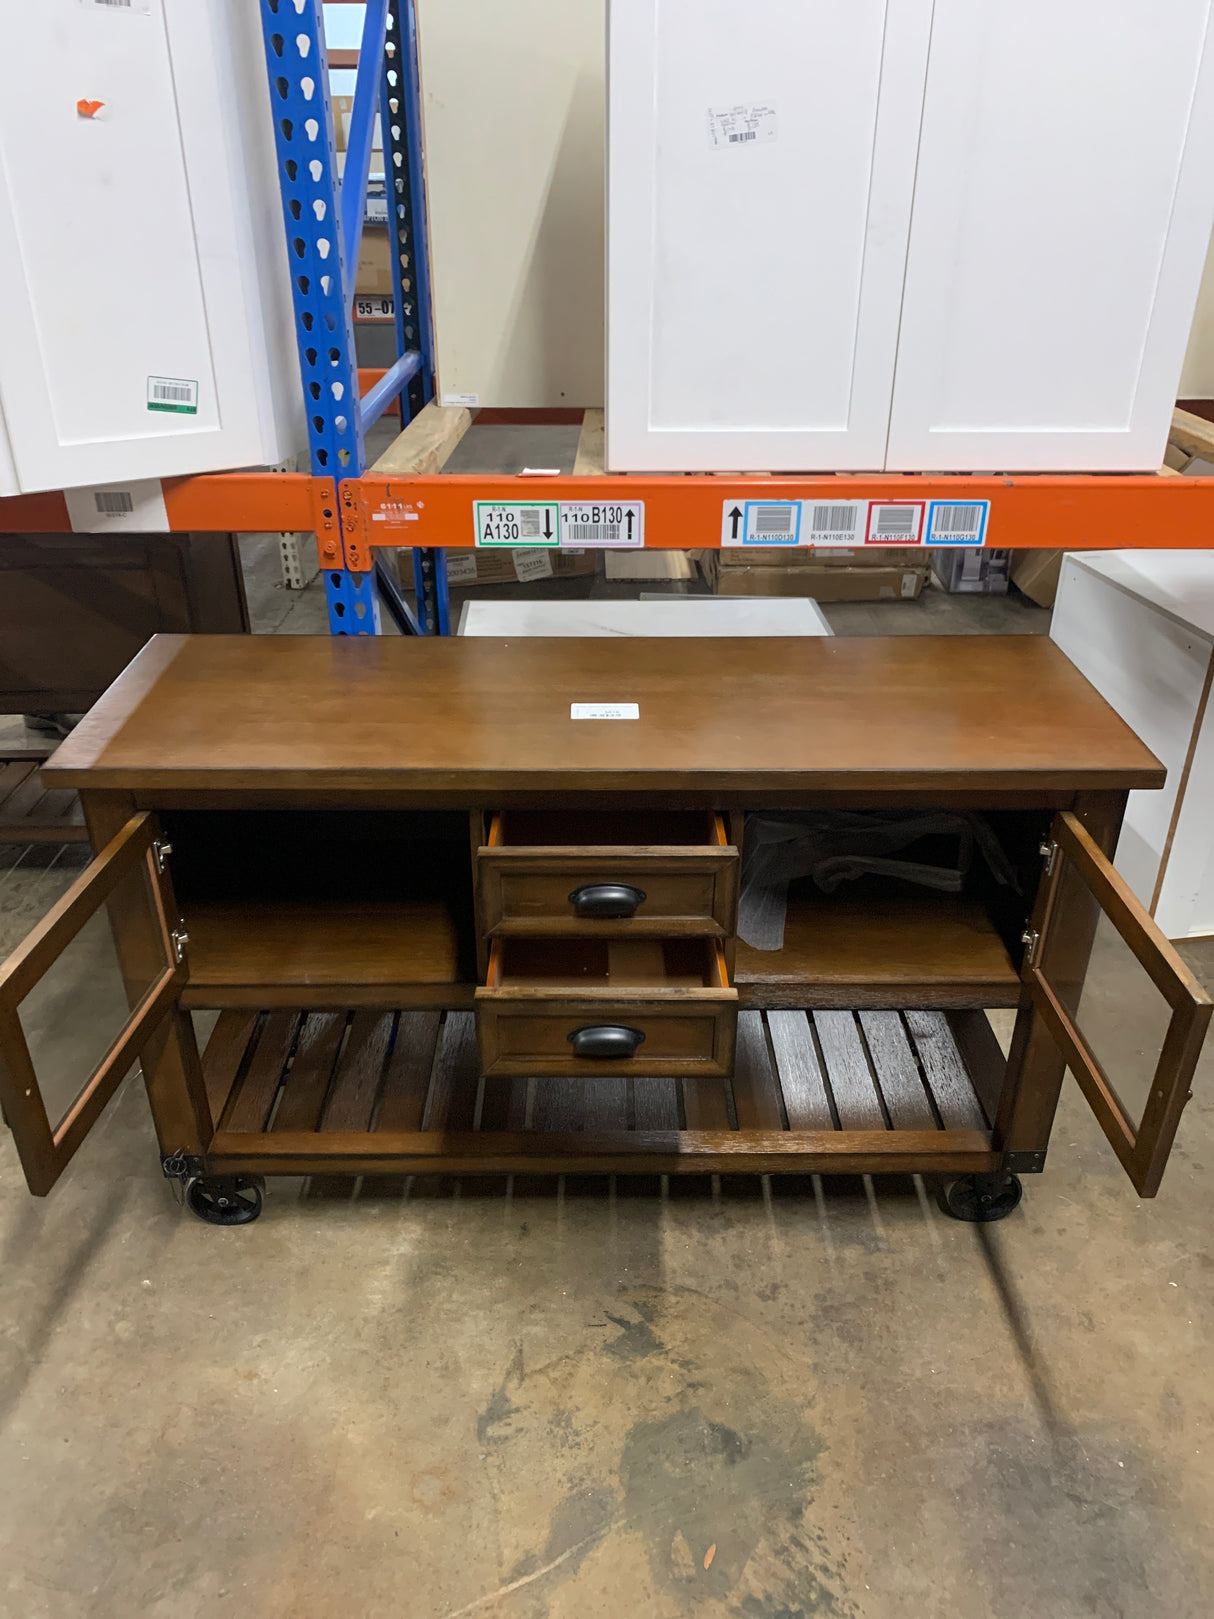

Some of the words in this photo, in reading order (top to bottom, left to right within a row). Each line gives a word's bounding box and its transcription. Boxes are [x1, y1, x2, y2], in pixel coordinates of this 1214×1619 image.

[486, 512, 515, 523] 110
[561, 513, 590, 523] 110
[592, 506, 623, 524] B130
[483, 523, 519, 540] A130
[749, 533, 795, 541] R-1-N110D130
[810, 533, 856, 541] R-1-N110E130
